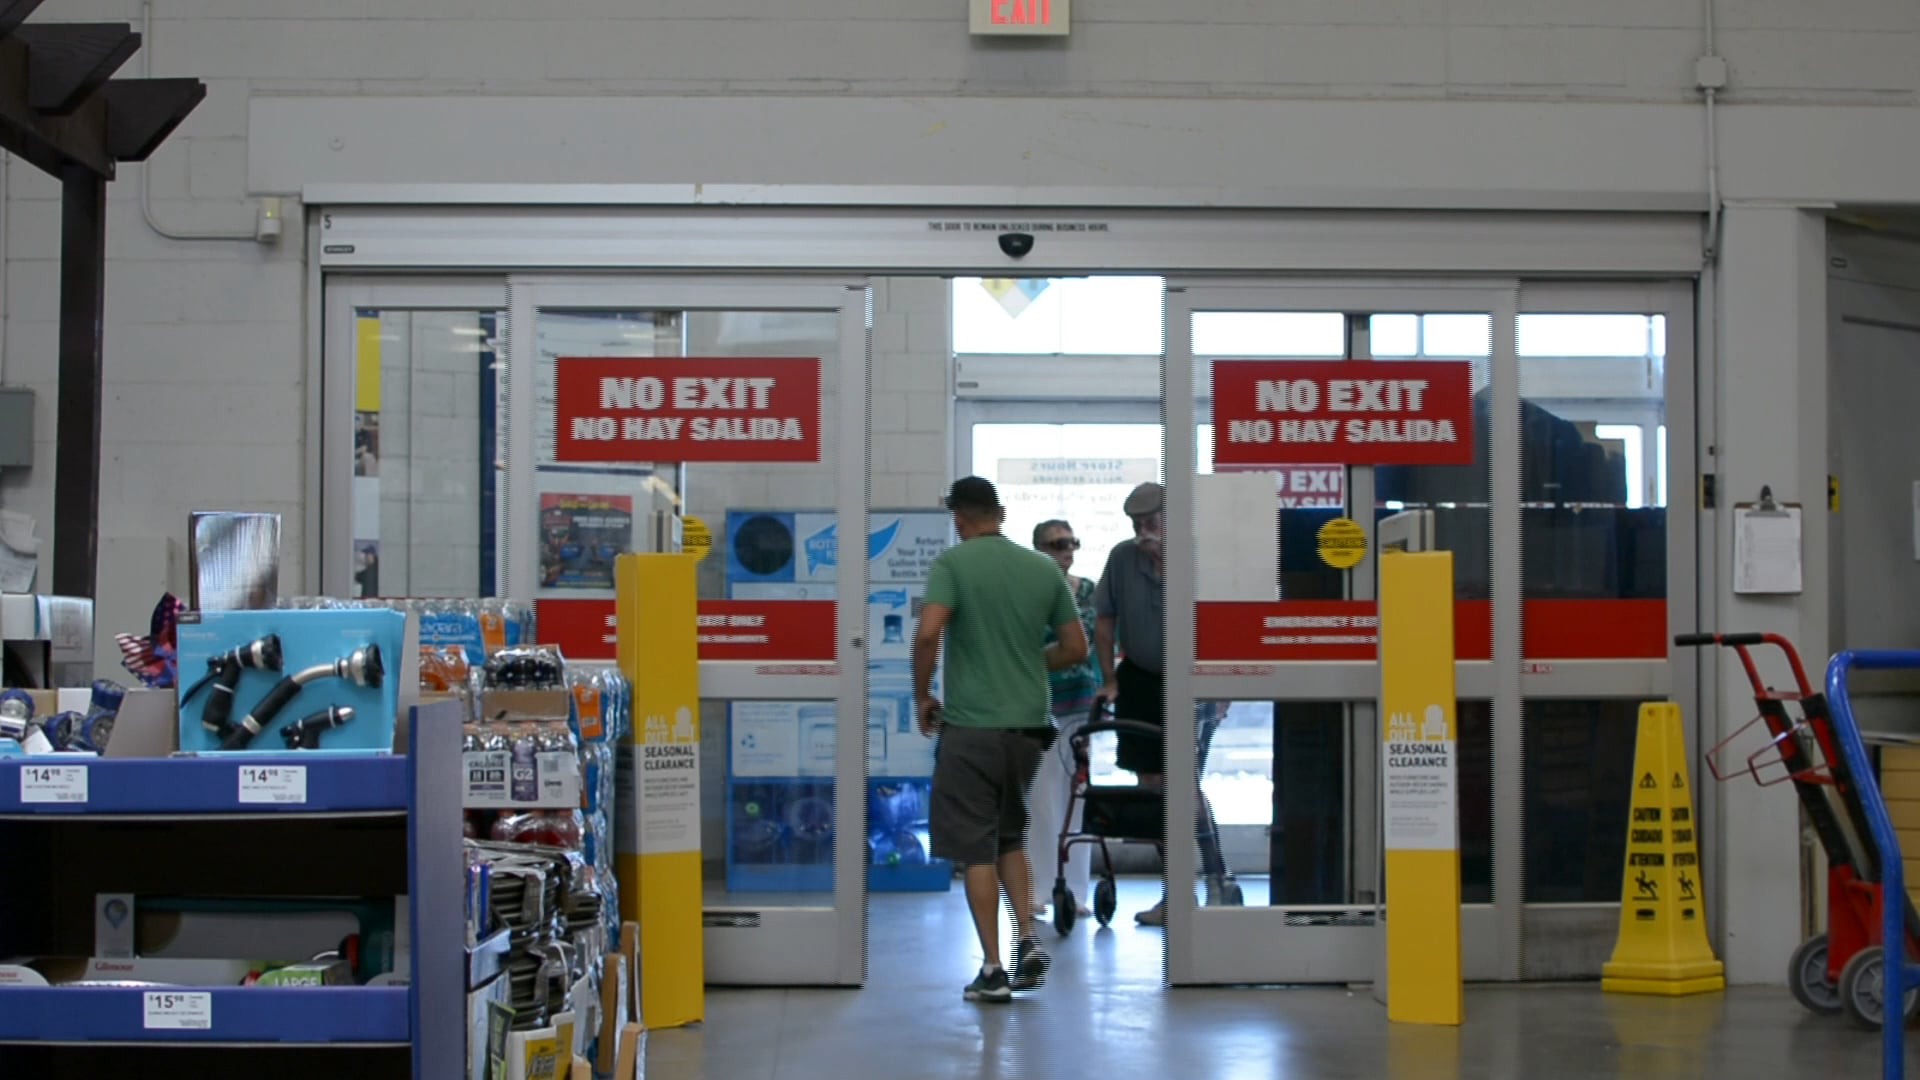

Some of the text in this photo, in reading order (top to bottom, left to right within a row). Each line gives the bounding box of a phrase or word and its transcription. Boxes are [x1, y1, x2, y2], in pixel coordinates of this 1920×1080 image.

[600, 376, 776, 410] NO EXIT
[1255, 379, 1430, 412] NO EXIT
[570, 416, 804, 441] NO HAY SALIDA
[1227, 419, 1458, 443] NO HAY SALIDA
[1264, 616, 1349, 628] EMERGENCY
[644, 745, 695, 758] SEASONAL
[1389, 743, 1448, 755] SEASONAL
[644, 758, 695, 771] CLEARANCE
[1388, 756, 1448, 768] CLEARANCE
[514, 767, 534, 781] G2
